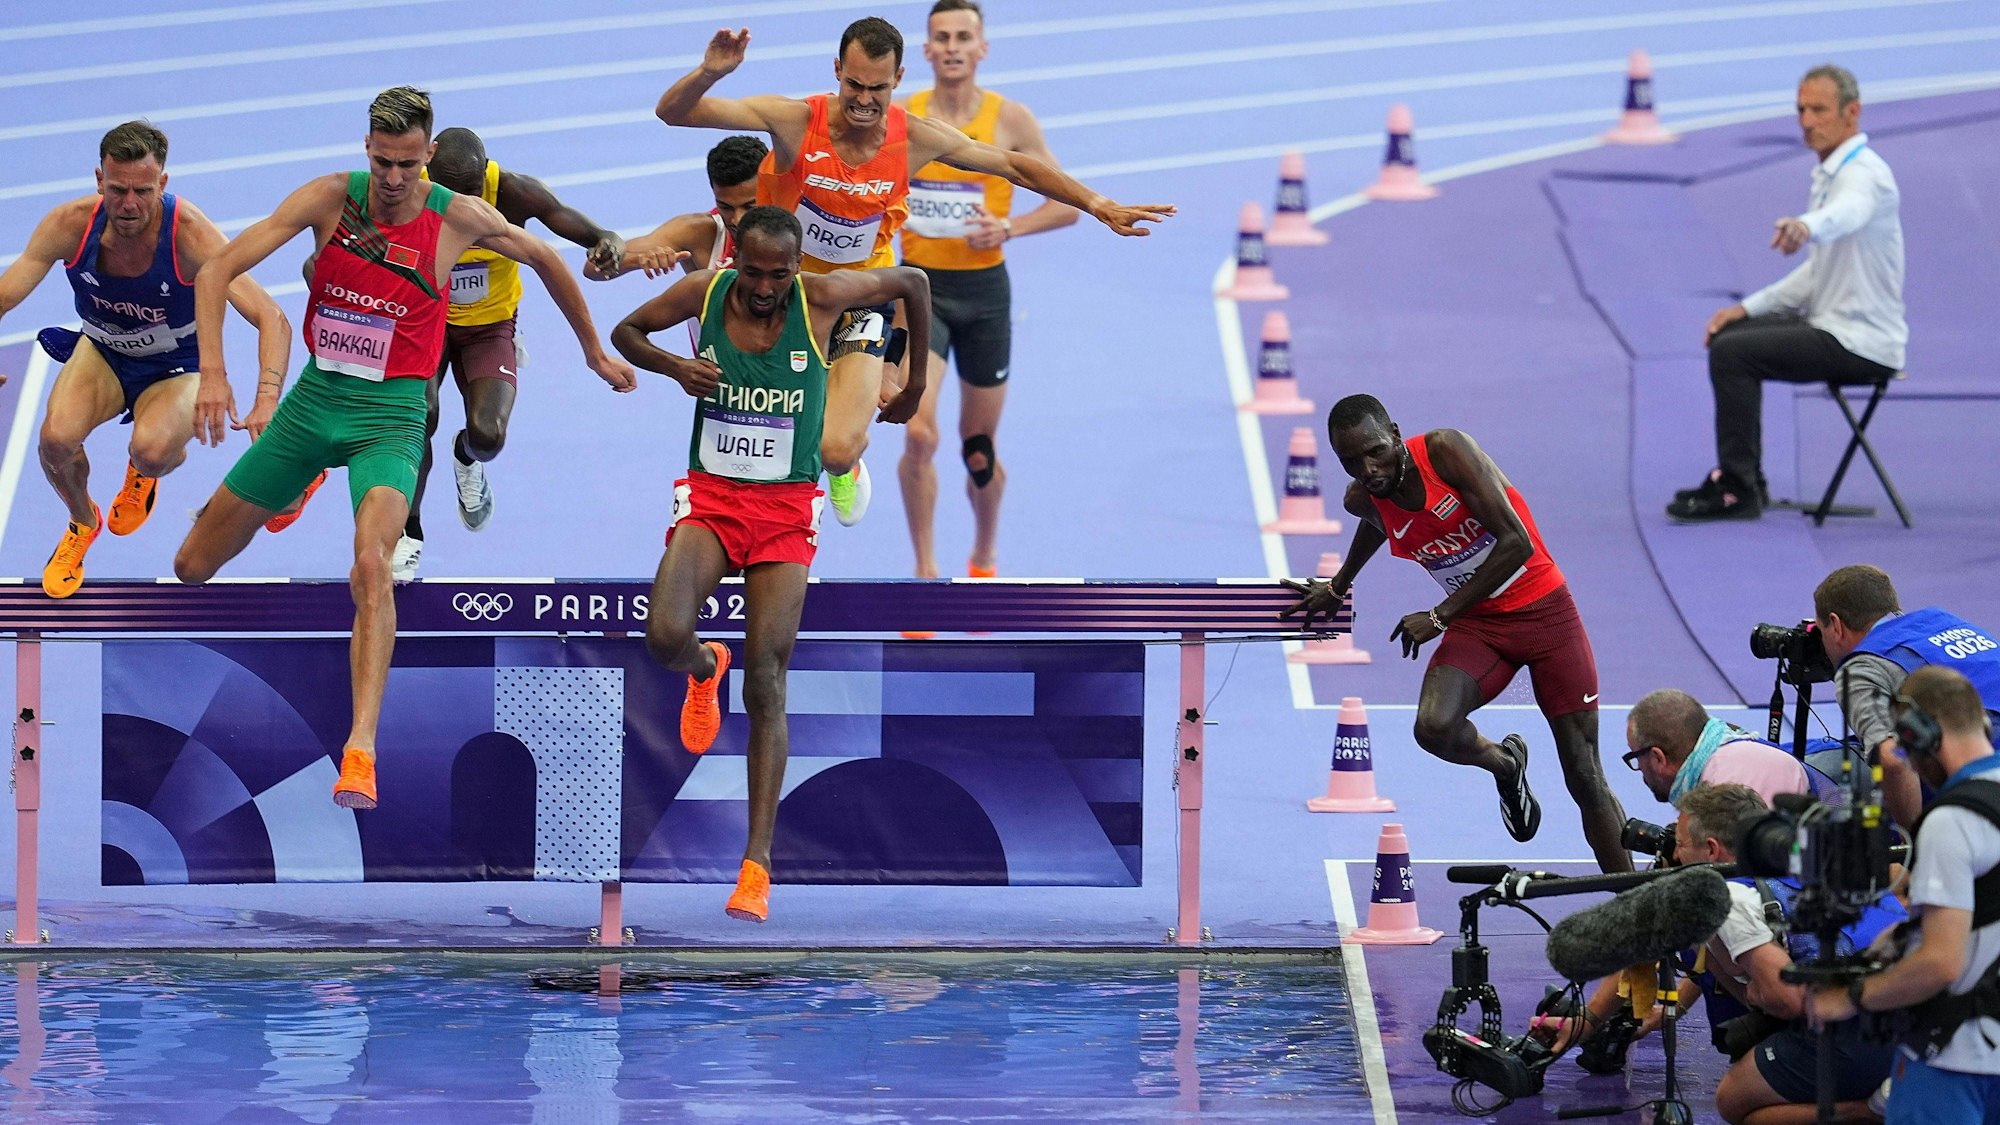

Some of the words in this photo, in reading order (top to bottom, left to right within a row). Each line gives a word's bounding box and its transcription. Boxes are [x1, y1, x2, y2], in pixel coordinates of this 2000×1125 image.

[804, 174, 895, 196] ESPAÑA
[806, 223, 865, 249] ARCE
[450, 274, 484, 291] UTAI
[349, 314, 371, 324] 2024
[860, 318, 871, 333] 7
[318, 328, 386, 360] BAKKALI
[717, 433, 775, 457] WALE
[1411, 517, 1482, 562] KENYA
[698, 595, 746, 620] 02
[1927, 628, 1977, 647] PHOTO
[1944, 635, 1998, 659] 0026
[1335, 749, 1370, 760] 2024
